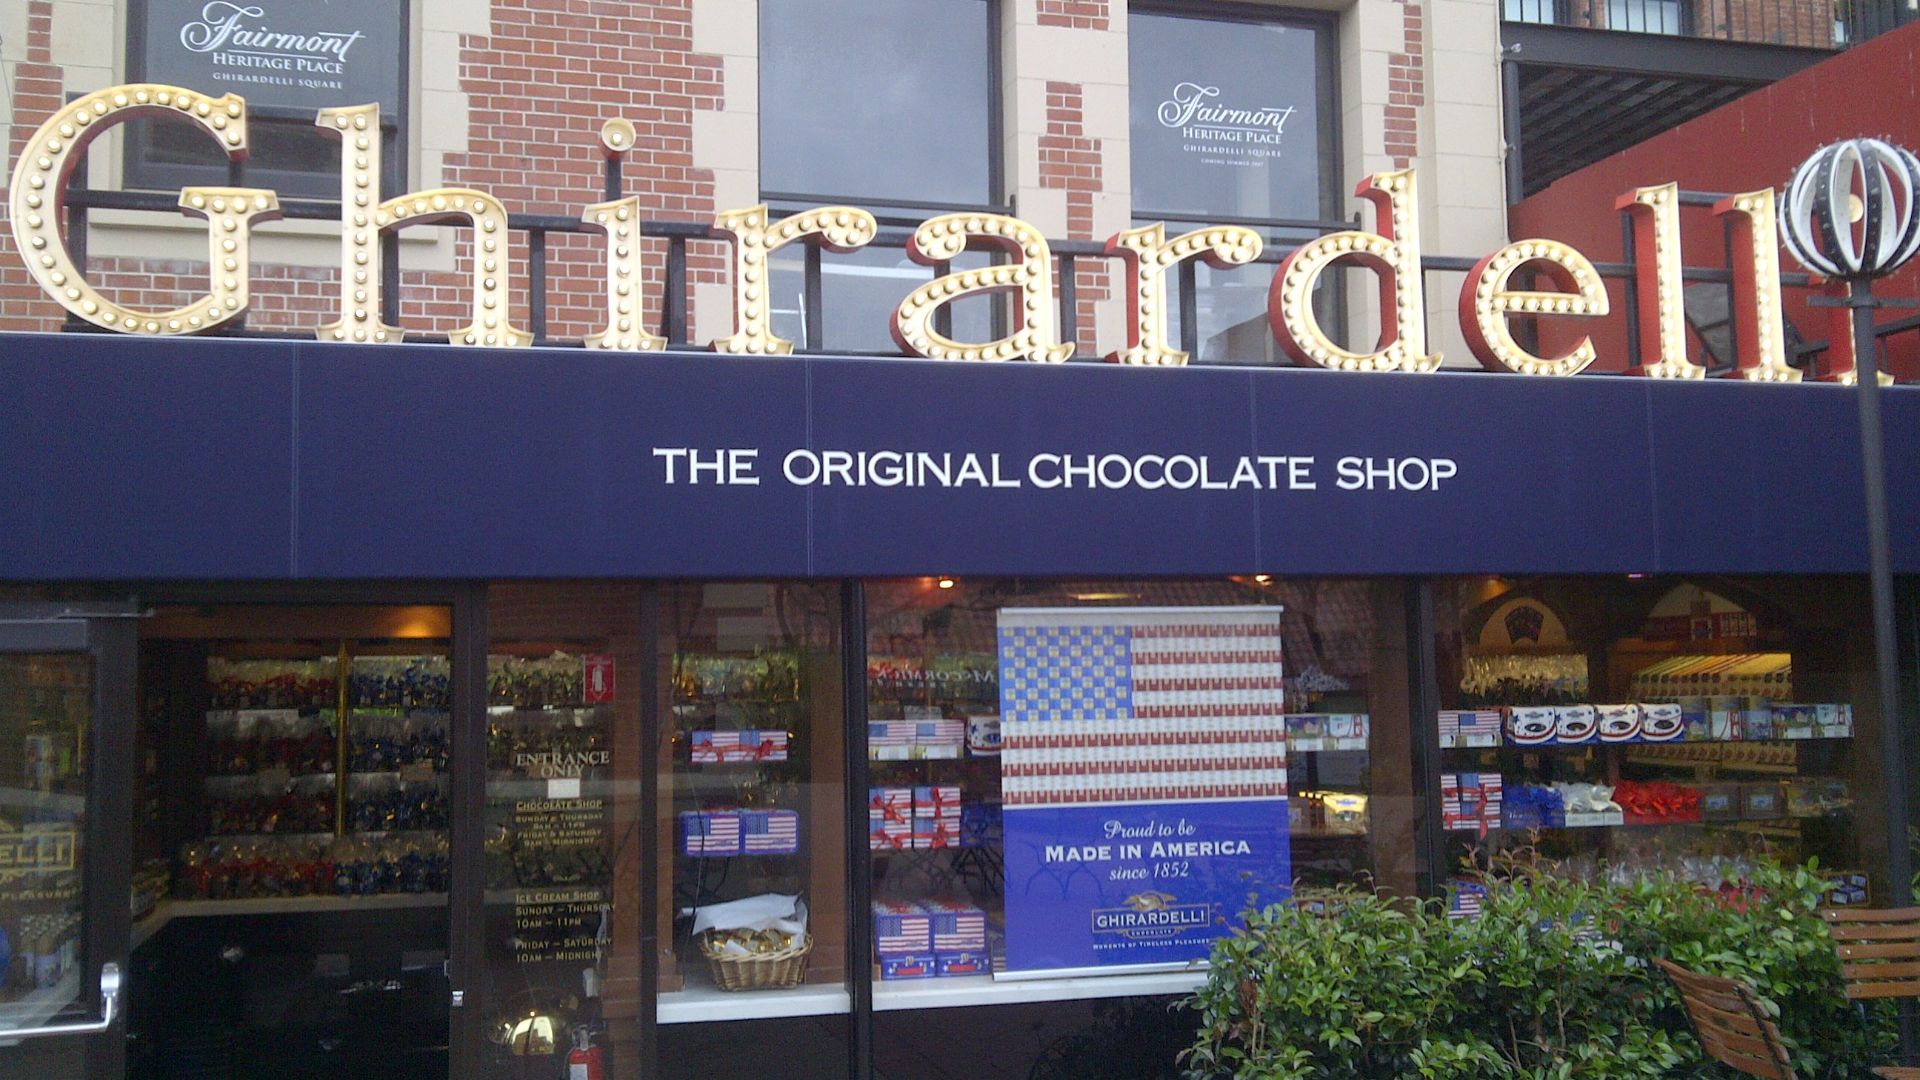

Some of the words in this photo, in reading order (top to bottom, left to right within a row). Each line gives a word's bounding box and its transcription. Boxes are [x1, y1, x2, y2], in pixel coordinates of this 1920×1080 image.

[180, 1, 366, 62] Fairmont
[213, 53, 292, 70] HERITAGE
[297, 59, 344, 74] PLACE
[213, 73, 293, 86] GHIRARDELLI
[298, 79, 343, 90] SQUARE
[1157, 82, 1297, 133] Fairmont
[1183, 127, 1243, 142] HERITAGE
[1246, 132, 1282, 145] PLACE
[1183, 144, 1244, 155] GHIRARDELLI
[1248, 147, 1281, 157] SQUARE
[8, 83, 1896, 386] Ghirardell
[652, 448, 760, 485] THE
[782, 449, 1021, 487] ORIGINAL
[1027, 453, 1316, 489] CHOCOLATE
[1335, 457, 1458, 491] SHOP
[516, 751, 610, 766] ENTRANCE
[541, 764, 584, 778] ONLY
[516, 801, 570, 811] CHOCOLATE
[576, 800, 602, 809] SHOP
[1104, 819, 1155, 840] Proud
[1159, 823, 1174, 836] to
[1178, 818, 1196, 836] be
[1045, 845, 1111, 863] MADE
[1119, 844, 1142, 860] IN
[1150, 840, 1251, 858] AMERICA
[1109, 866, 1150, 881] since
[1153, 862, 1190, 878] 1852
[516, 894, 532, 902] ICE
[535, 892, 569, 902] CREAM
[573, 891, 599, 900] SHOP
[516, 906, 553, 916] SUNDAY
[567, 903, 616, 913] THURSDAY
[517, 919, 542, 928] 10AM
[557, 917, 581, 927] 11PM
[1097, 910, 1204, 928] GHIRARDELLI
[515, 940, 550, 950] FRIDAY
[563, 938, 612, 948] SATURDAY
[517, 953, 542, 963] 10AM
